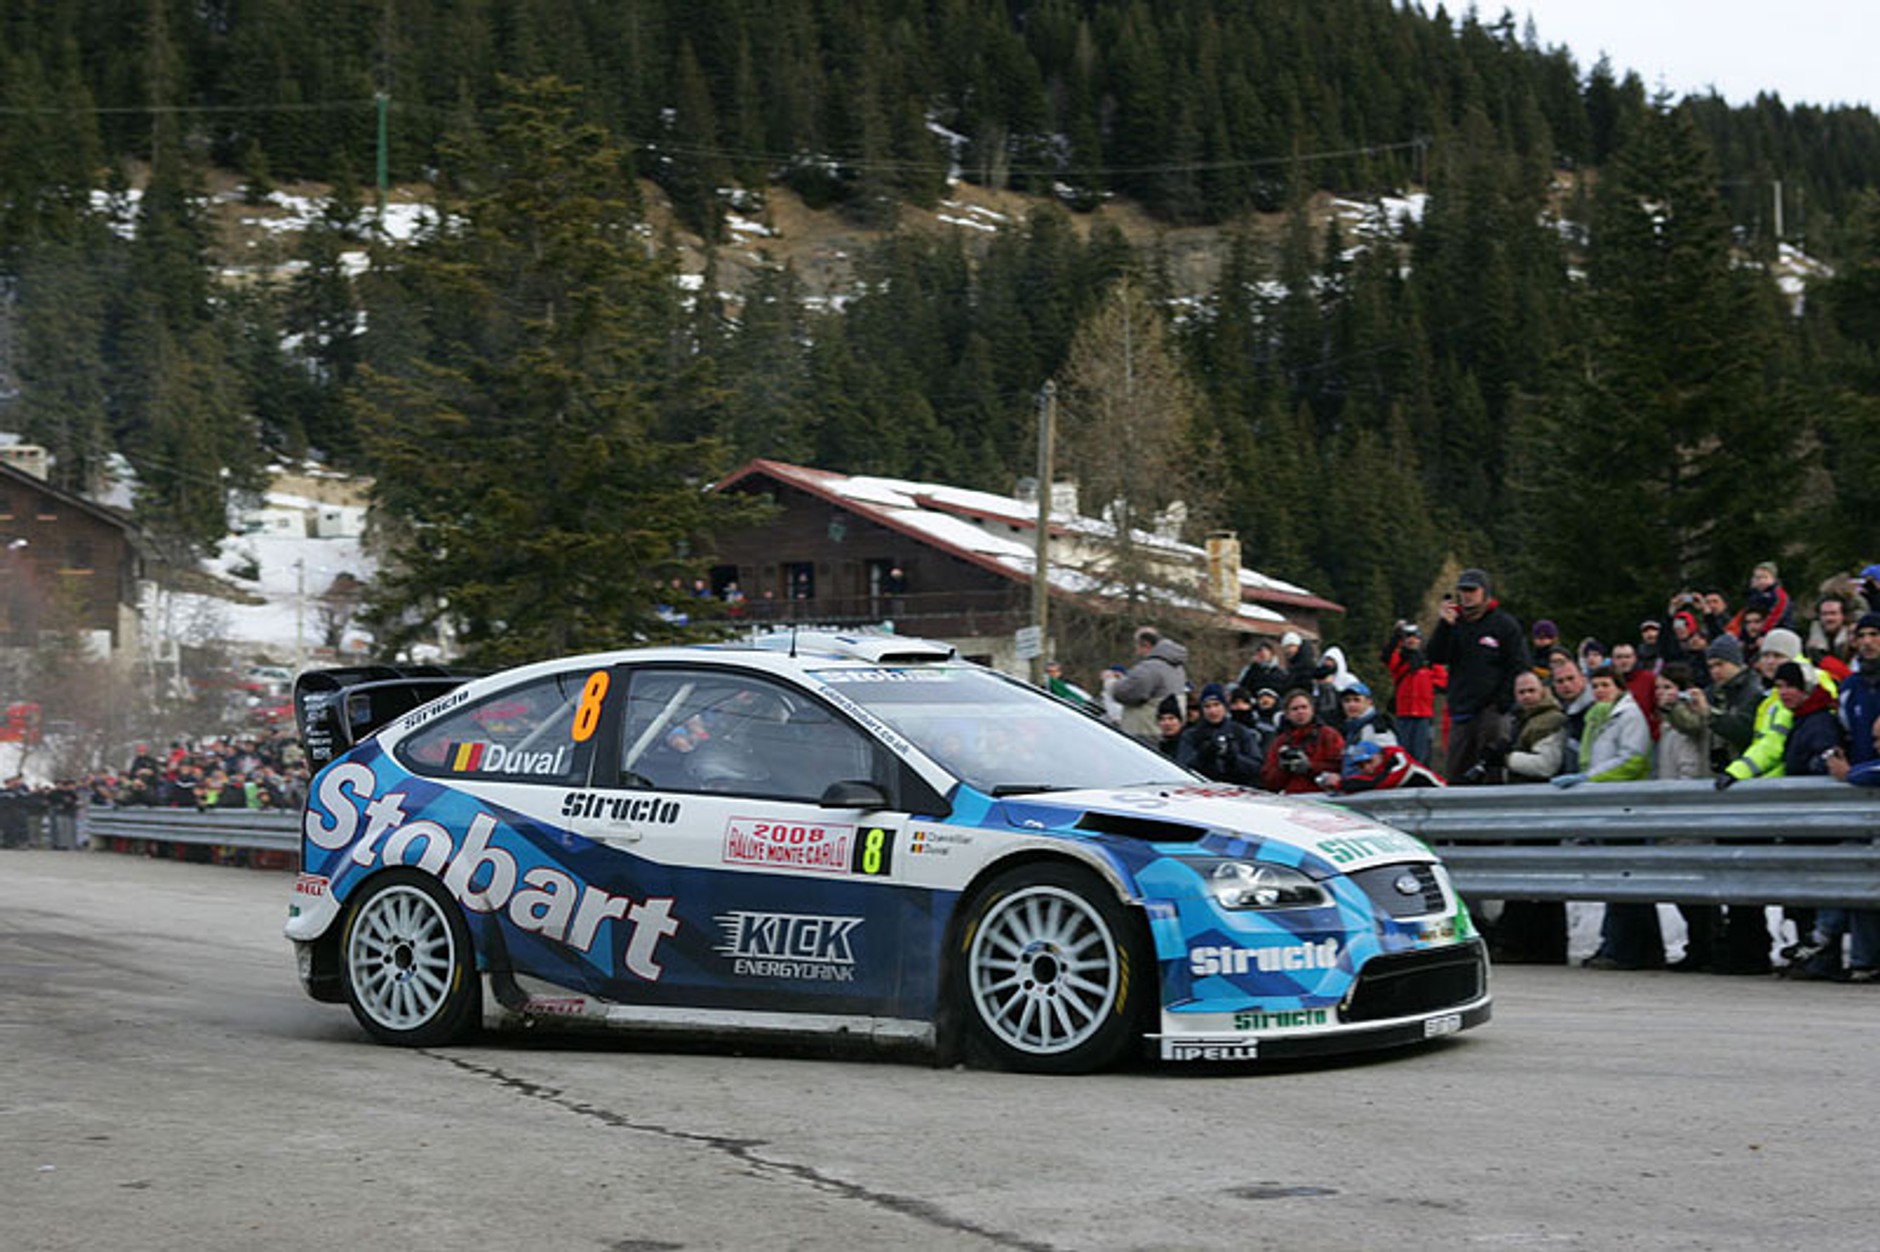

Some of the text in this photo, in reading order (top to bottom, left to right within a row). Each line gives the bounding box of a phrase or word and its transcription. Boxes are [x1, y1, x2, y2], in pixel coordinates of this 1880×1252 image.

[571, 670, 610, 742] 8
[482, 743, 565, 775] Duval
[561, 792, 681, 824] Structo
[729, 827, 847, 868] RALLYE MONTE CARLO
[753, 823, 825, 845] 2008
[862, 827, 885, 874] 8
[304, 762, 680, 981] Stobart
[734, 911, 865, 964] KICK
[1160, 1037, 1259, 1061] PIRELLI
